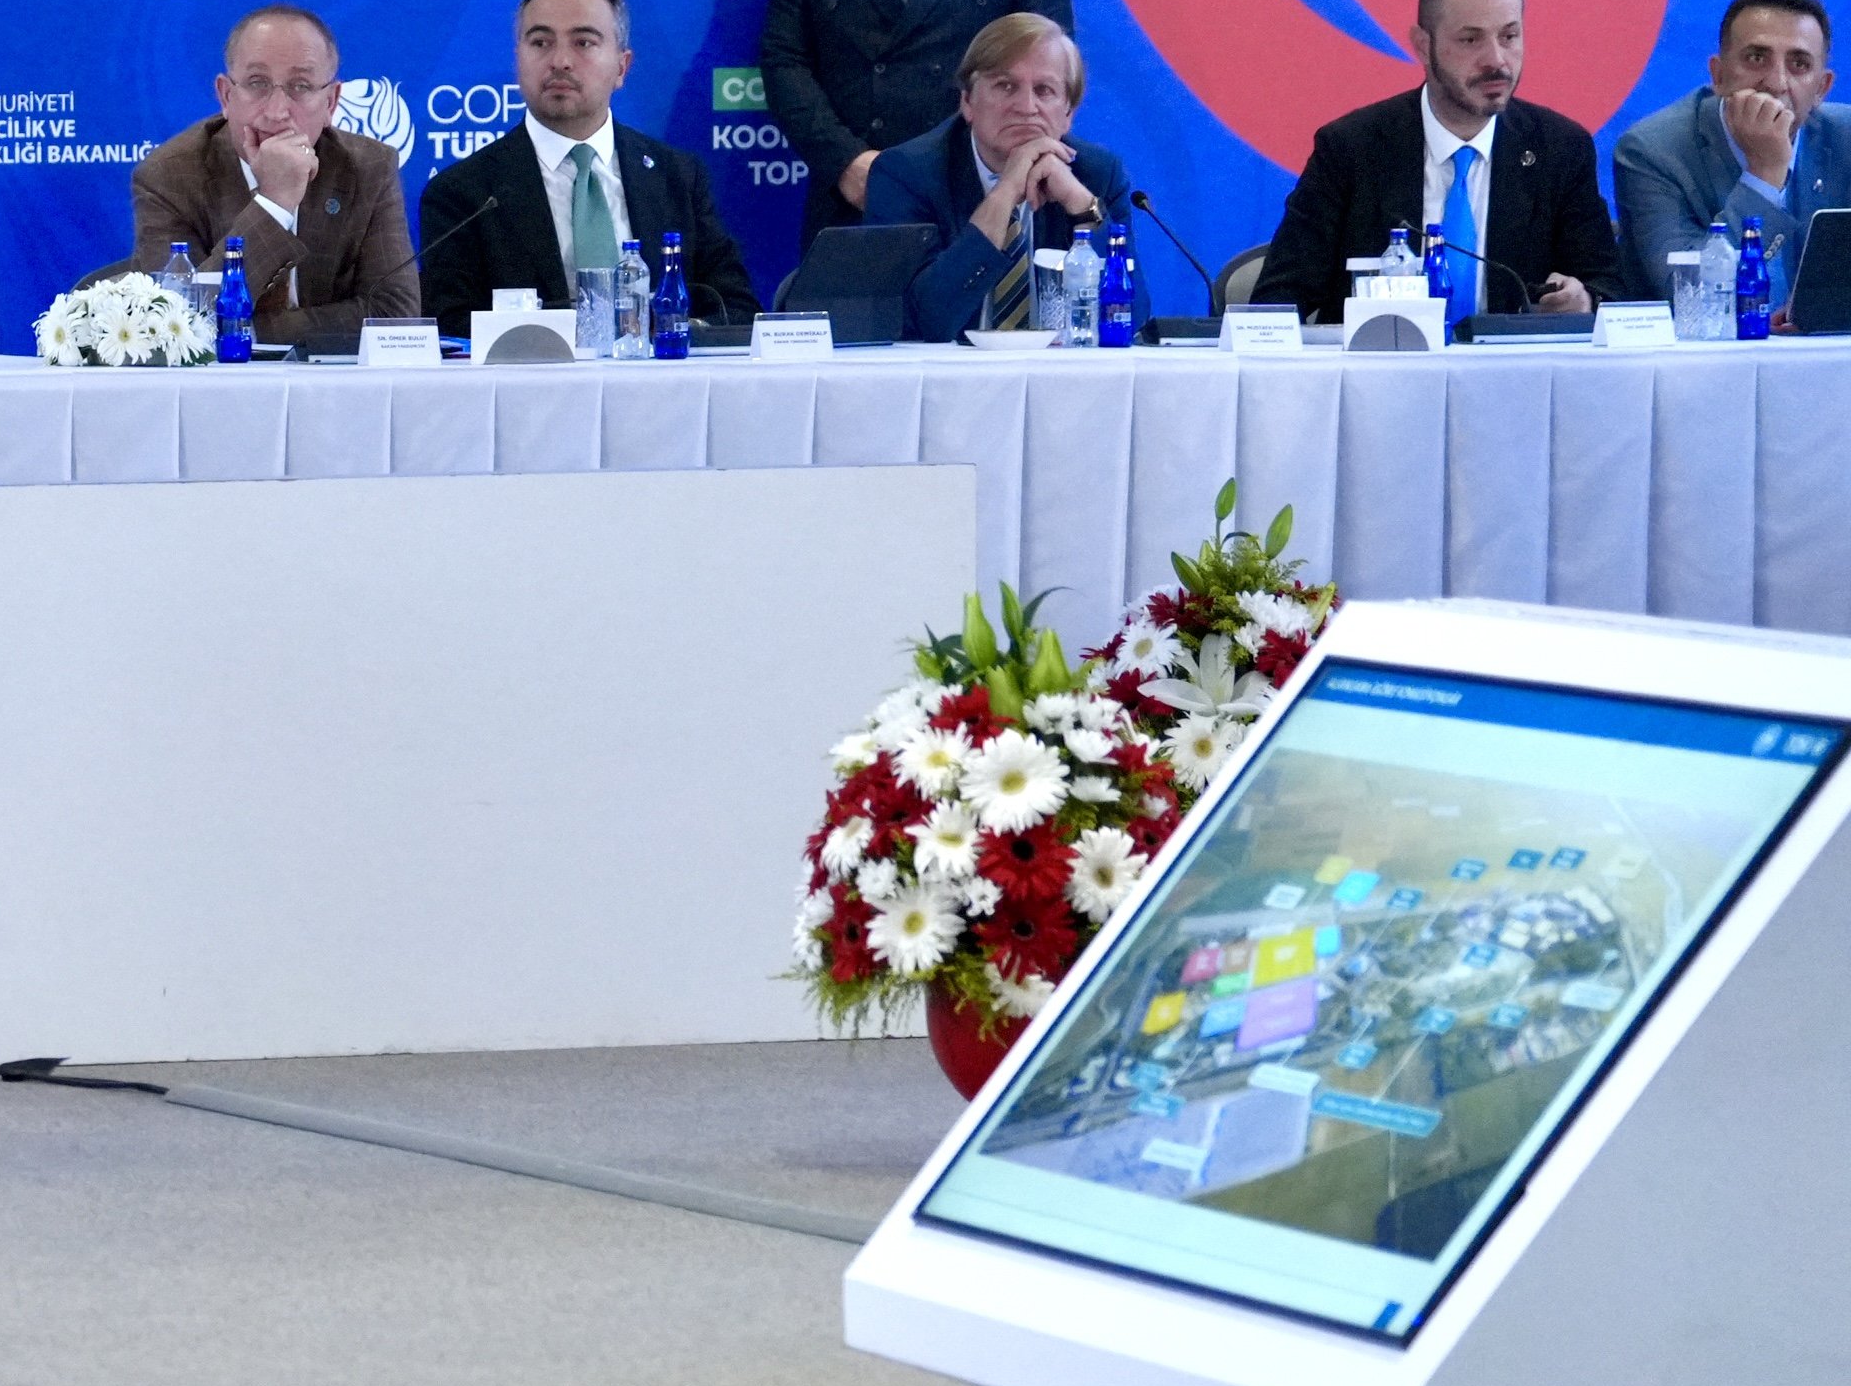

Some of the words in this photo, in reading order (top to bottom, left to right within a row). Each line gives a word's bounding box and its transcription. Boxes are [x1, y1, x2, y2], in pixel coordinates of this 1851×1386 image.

[427, 84, 527, 124] COP
[49, 119, 76, 138] VE
[47, 139, 161, 163] BAKANLIĞ
